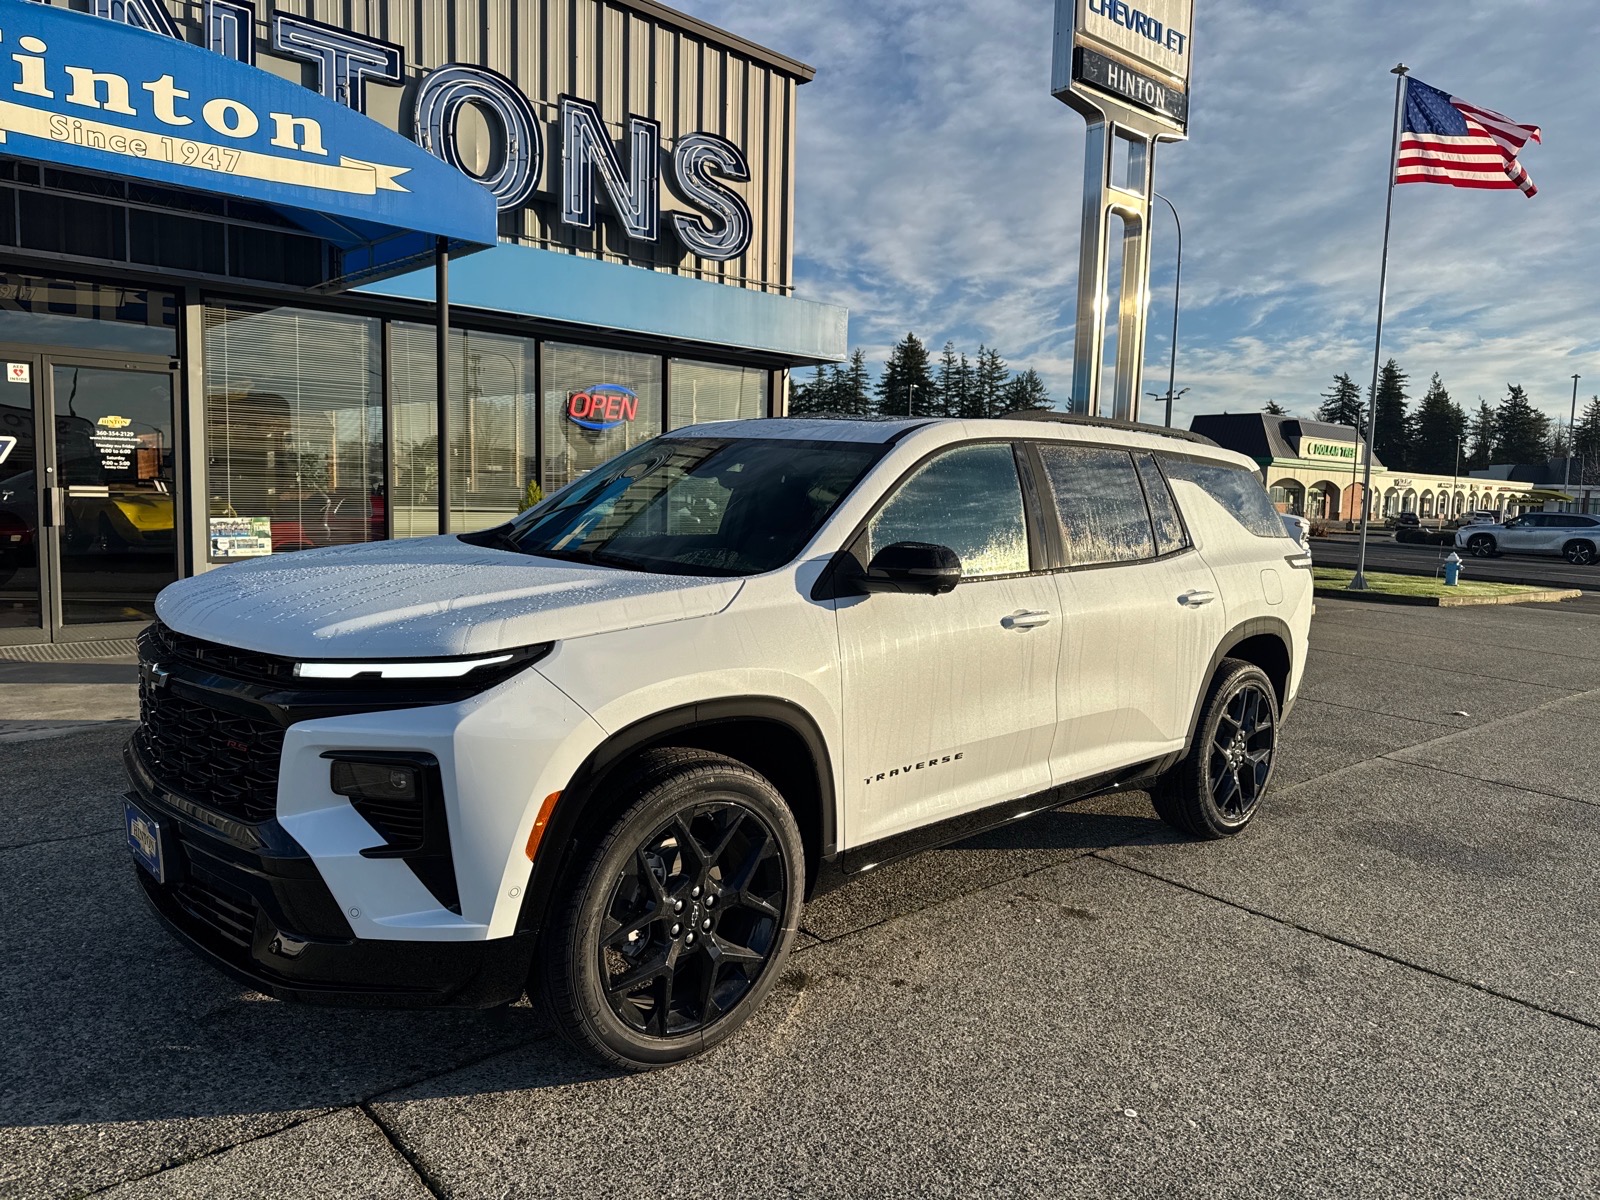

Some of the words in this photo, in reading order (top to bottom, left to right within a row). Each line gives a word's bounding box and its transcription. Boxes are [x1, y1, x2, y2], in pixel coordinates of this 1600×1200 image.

[1088, 0, 1187, 55] CHEVROLET
[1107, 64, 1166, 109] HINTON
[49, 114, 148, 161] Since
[160, 136, 242, 173] 1947
[569, 392, 639, 420] OPEN
[864, 752, 963, 785] TRAVERSE
